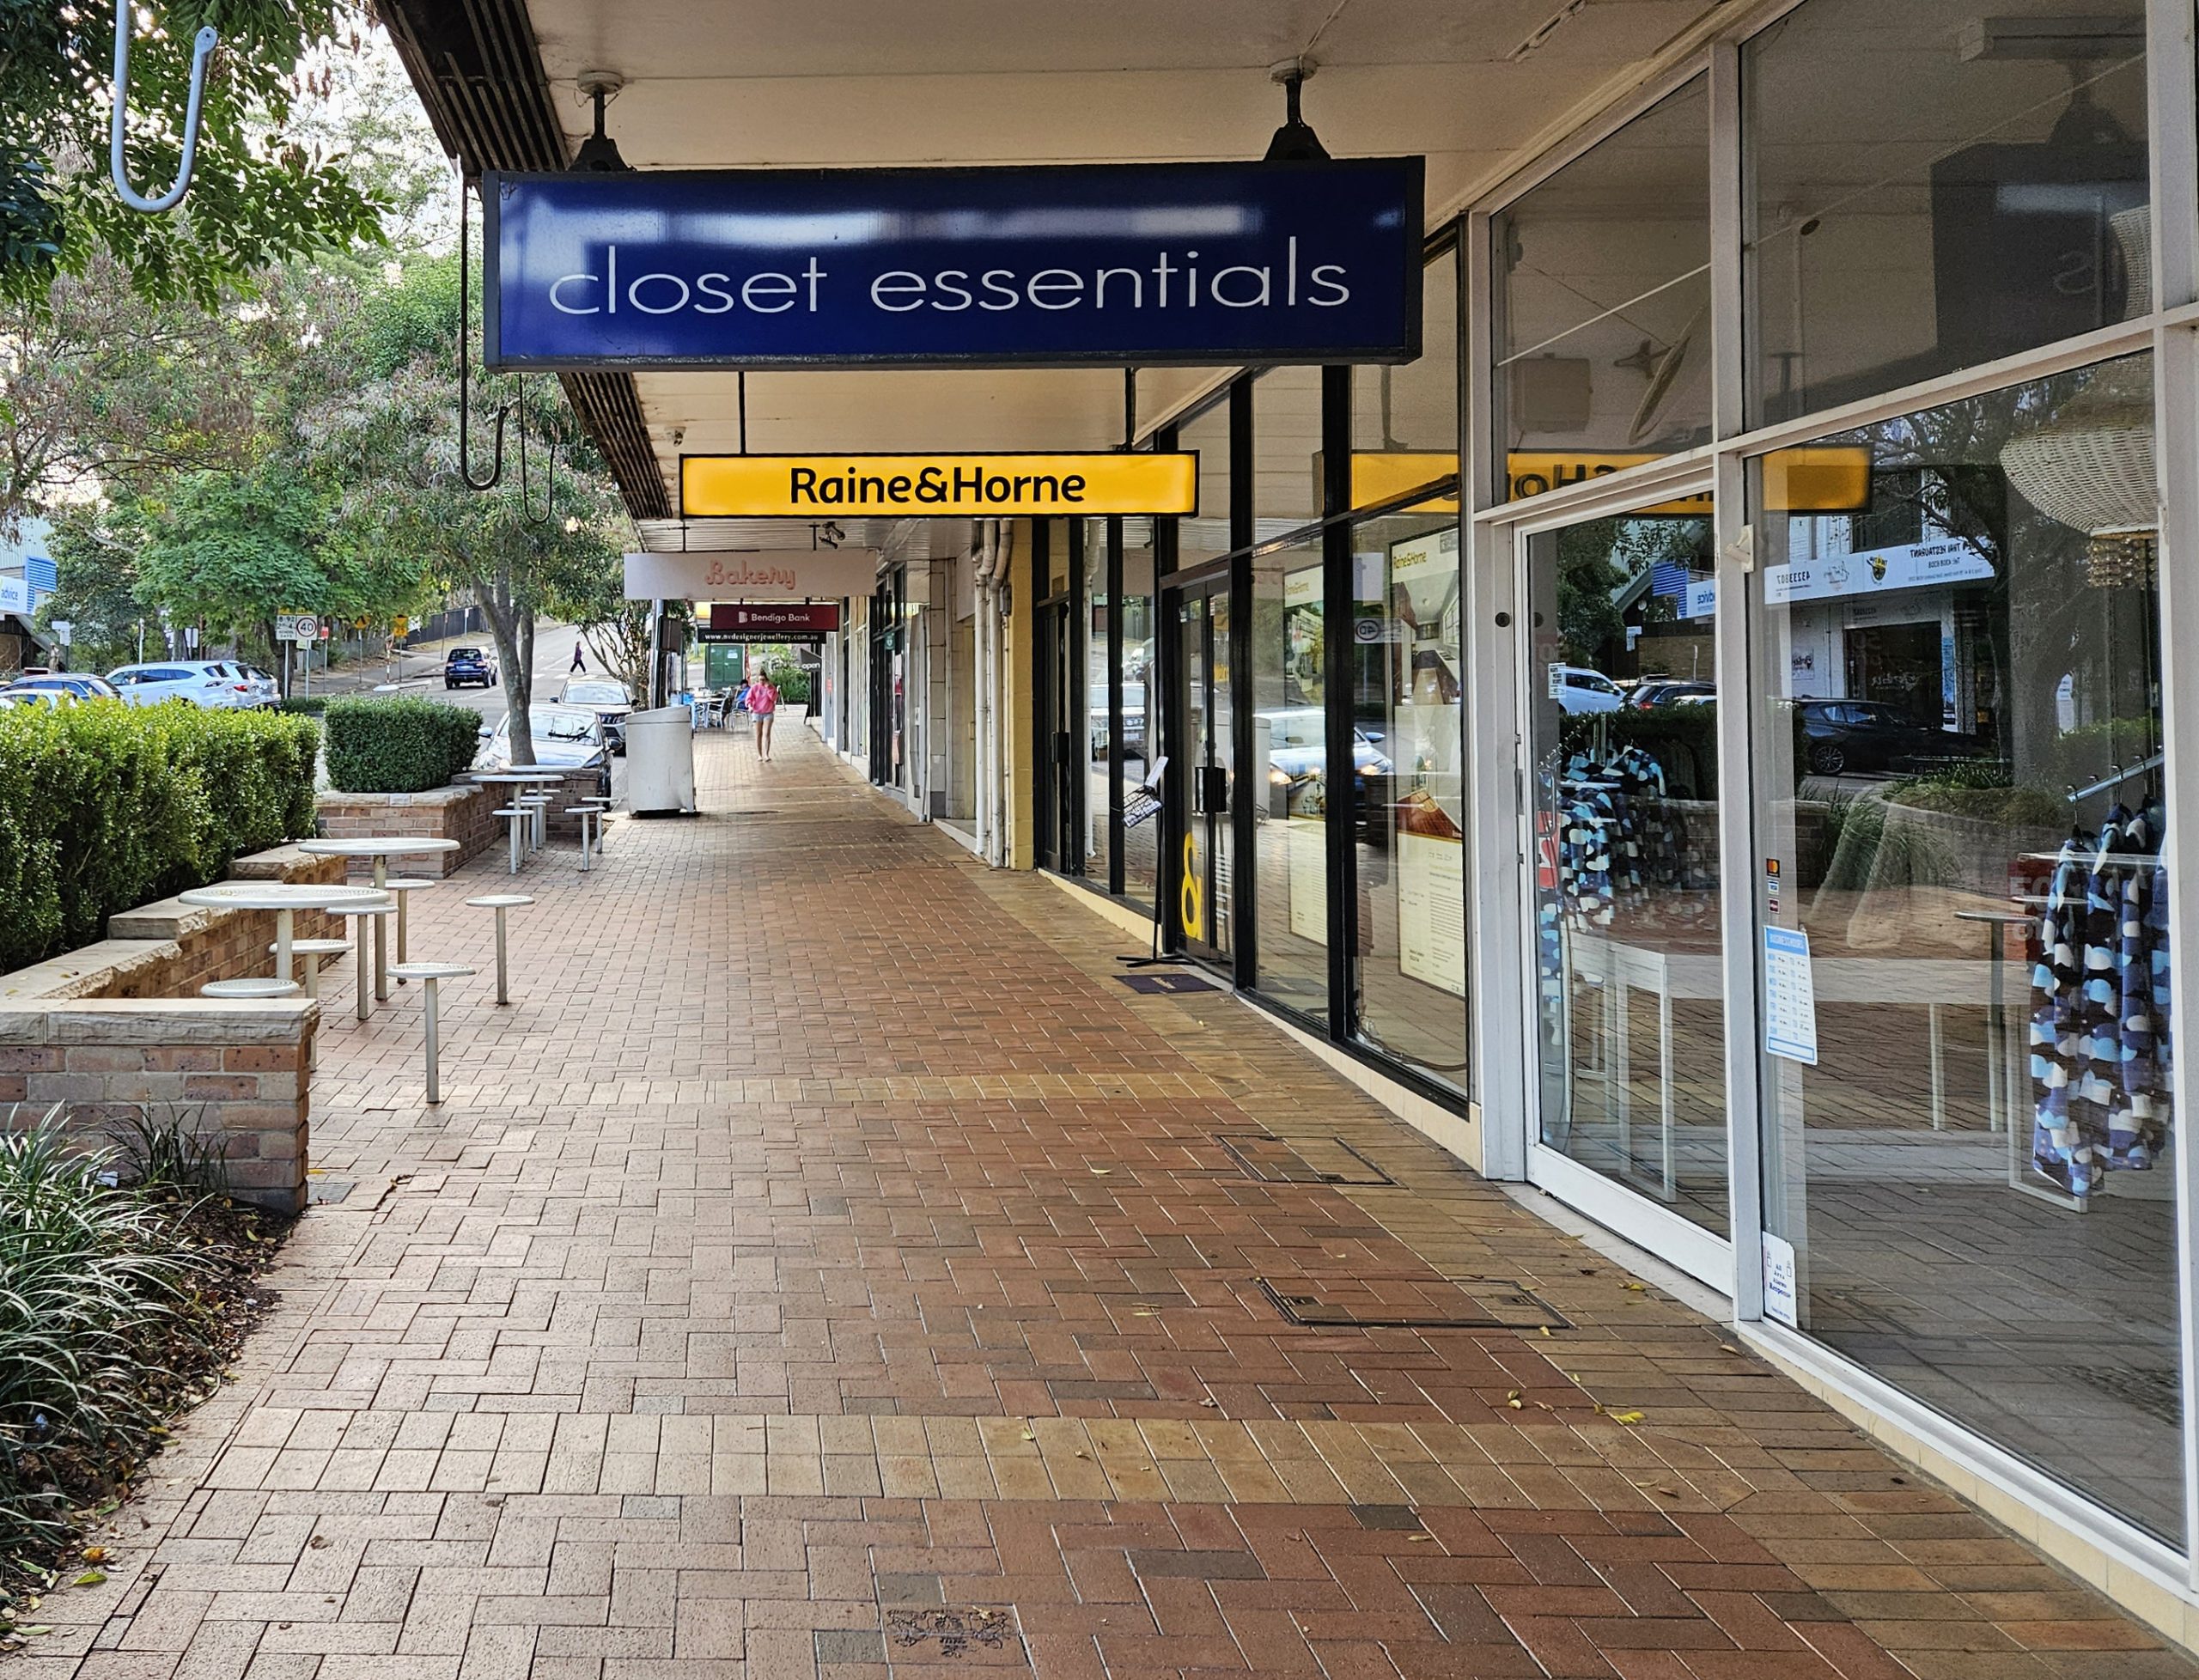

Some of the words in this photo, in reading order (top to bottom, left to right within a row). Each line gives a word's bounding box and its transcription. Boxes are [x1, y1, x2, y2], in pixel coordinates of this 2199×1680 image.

[547, 246, 828, 315] closet
[869, 236, 1352, 312] essentials
[790, 466, 1086, 504] Raine&Horne
[704, 559, 795, 590] Bakery
[300, 623, 314, 632] 40
[751, 612, 787, 624] Bendigo
[788, 612, 810, 622] Bank
